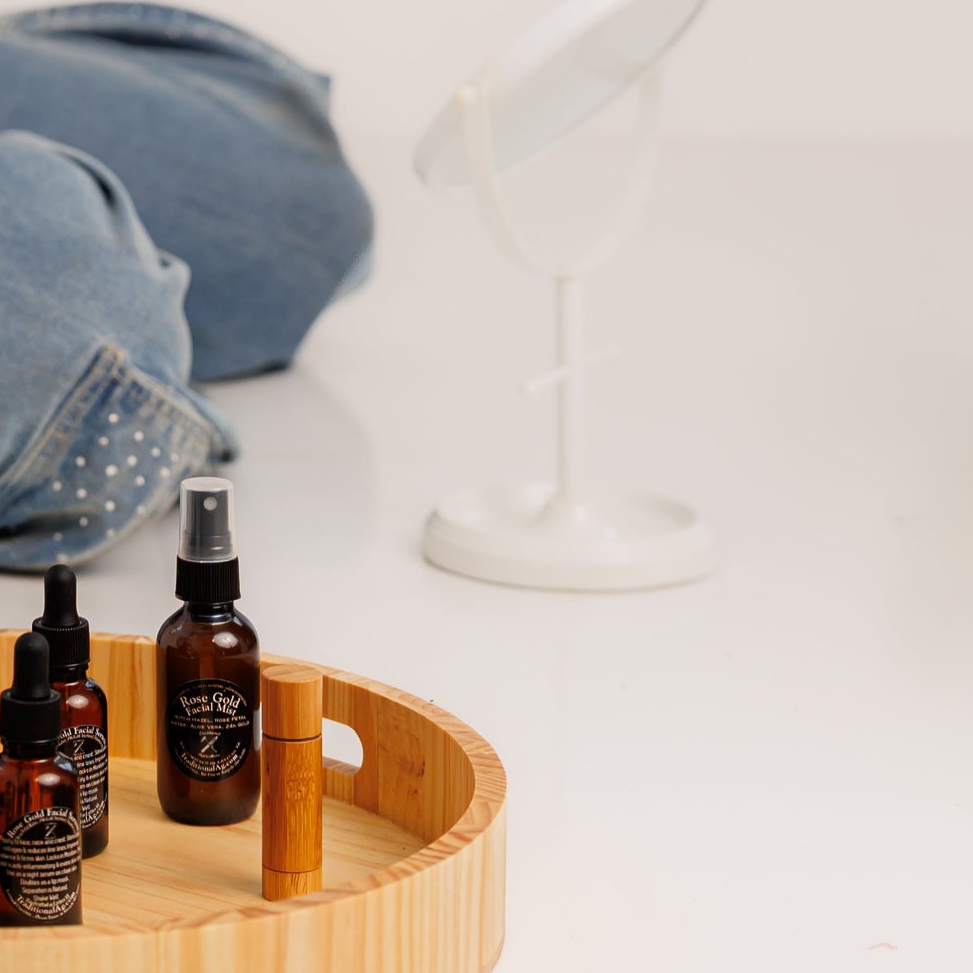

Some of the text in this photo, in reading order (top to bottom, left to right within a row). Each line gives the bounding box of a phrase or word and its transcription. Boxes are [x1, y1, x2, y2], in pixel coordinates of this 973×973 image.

[180, 695, 208, 708] Rose
[212, 692, 241, 709] Gold
[185, 702, 237, 717] Facial Mist
[74, 725, 95, 735] Facial
[7, 822, 23, 839] Rose
[24, 810, 45, 823] Gold
[47, 808, 68, 817] Facial
